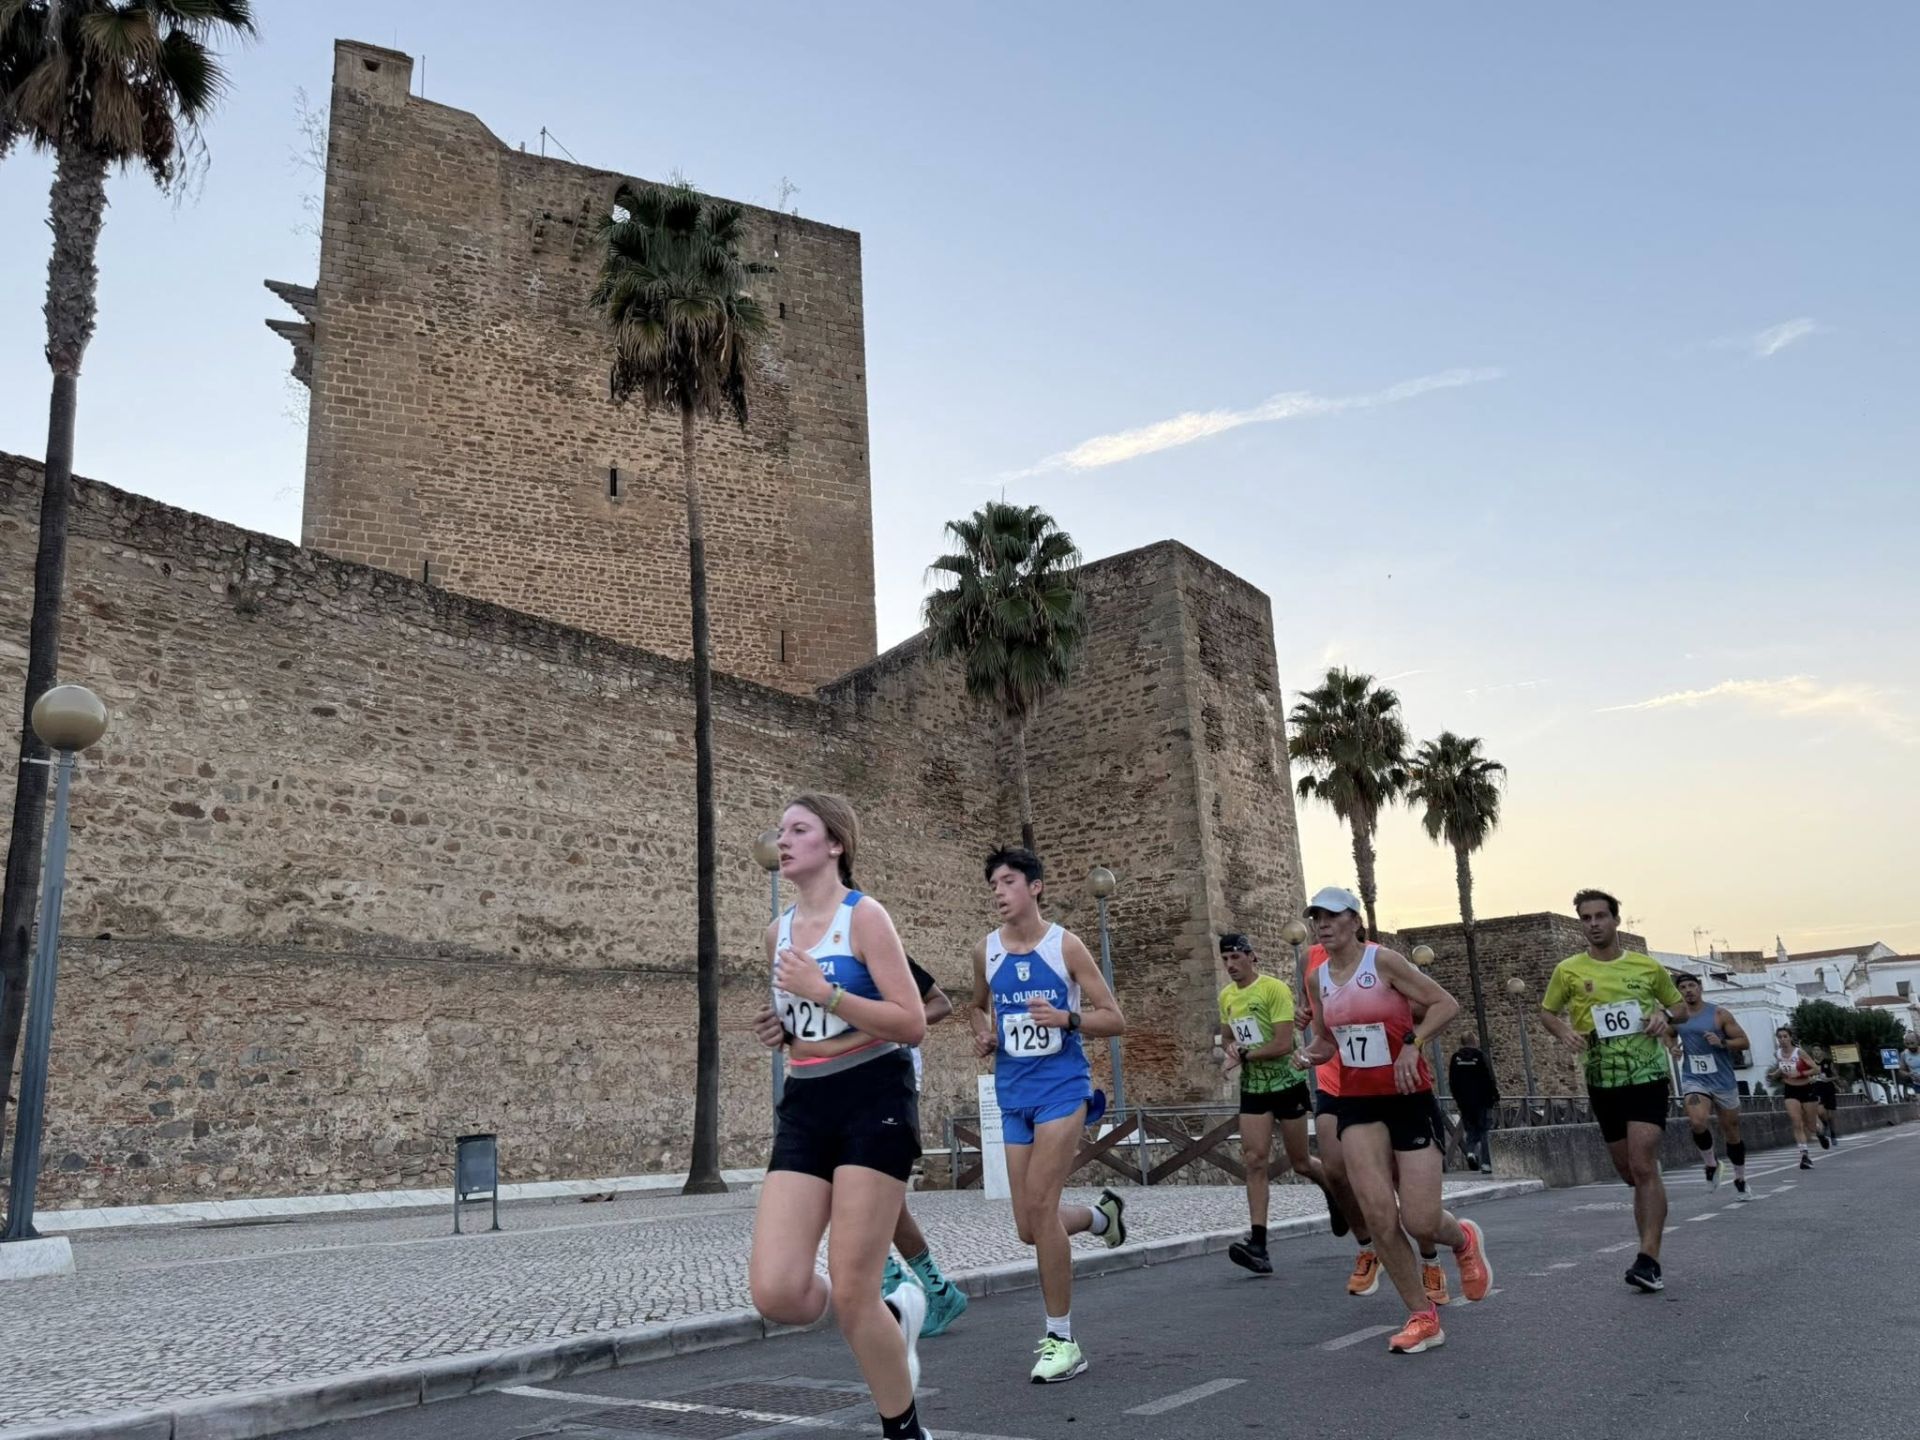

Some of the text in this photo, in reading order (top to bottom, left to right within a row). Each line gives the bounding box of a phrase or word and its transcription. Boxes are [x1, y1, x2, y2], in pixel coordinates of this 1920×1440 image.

[1604, 1010, 1630, 1032] 66
[1010, 1024, 1050, 1051] 129
[1236, 1024, 1252, 1042] 84
[1346, 1036, 1368, 1062] 17
[1694, 1060, 1708, 1072] 79
